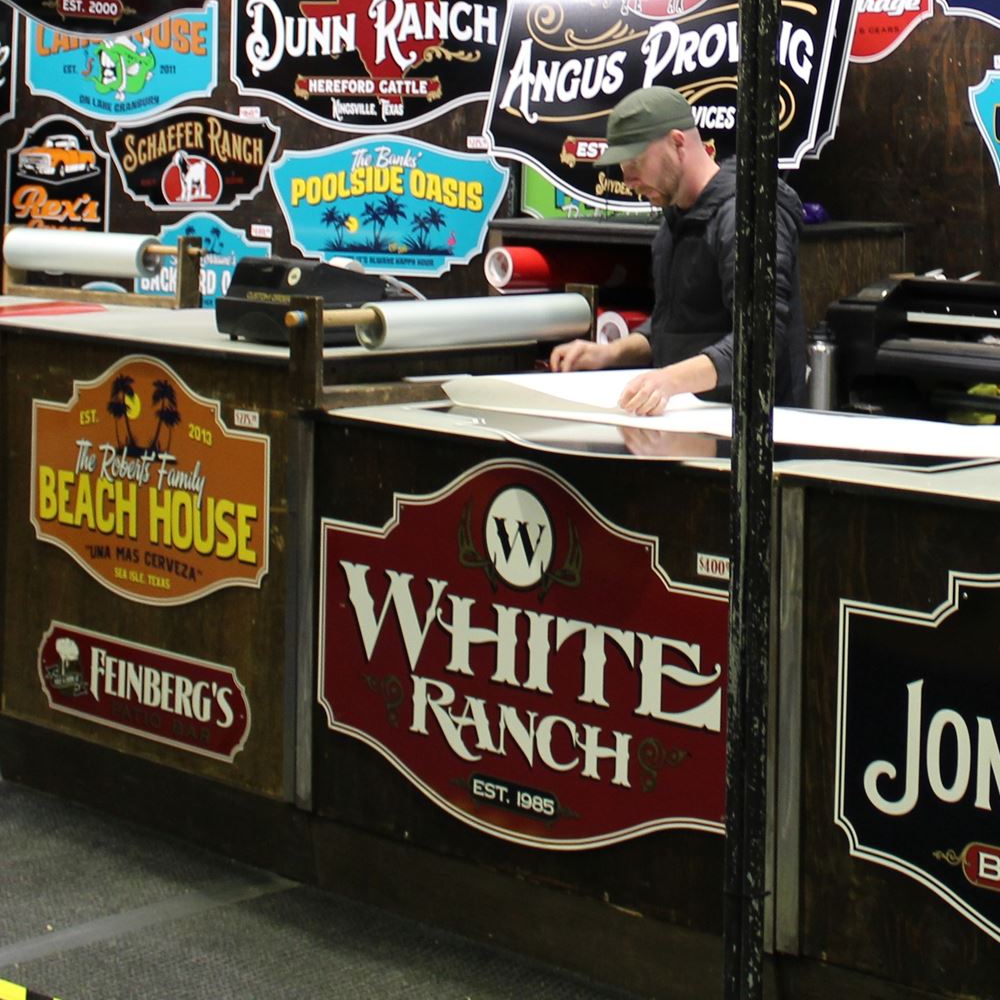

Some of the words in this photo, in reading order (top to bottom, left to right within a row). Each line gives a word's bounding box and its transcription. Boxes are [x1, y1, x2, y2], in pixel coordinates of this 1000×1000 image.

[62, 0, 85, 13] EST.
[88, 2, 118, 15] 2000
[308, 78, 376, 95] HEREFORD
[378, 78, 428, 95] CATTLE
[499, 37, 627, 125] ANGUS
[122, 120, 202, 173] SCHAEFER
[207, 115, 265, 165] RANCH
[351, 149, 375, 171] The
[13, 183, 102, 224] Rex's
[291, 166, 404, 207] POOLSIDE
[409, 168, 484, 212] OASIS
[80, 410, 99, 426] EST.
[188, 423, 213, 447] 2013
[75, 439, 97, 474] The
[156, 452, 207, 509] Family
[38, 465, 137, 541] BEACH
[148, 486, 258, 566] HOUSE
[115, 546, 141, 566] MAS
[492, 516, 545, 570] W
[339, 559, 723, 732] WHITE
[90, 645, 234, 729] FEINBERG'S
[409, 673, 633, 788] RANCH
[472, 778, 510, 805] EST.
[516, 790, 556, 816] 1985
